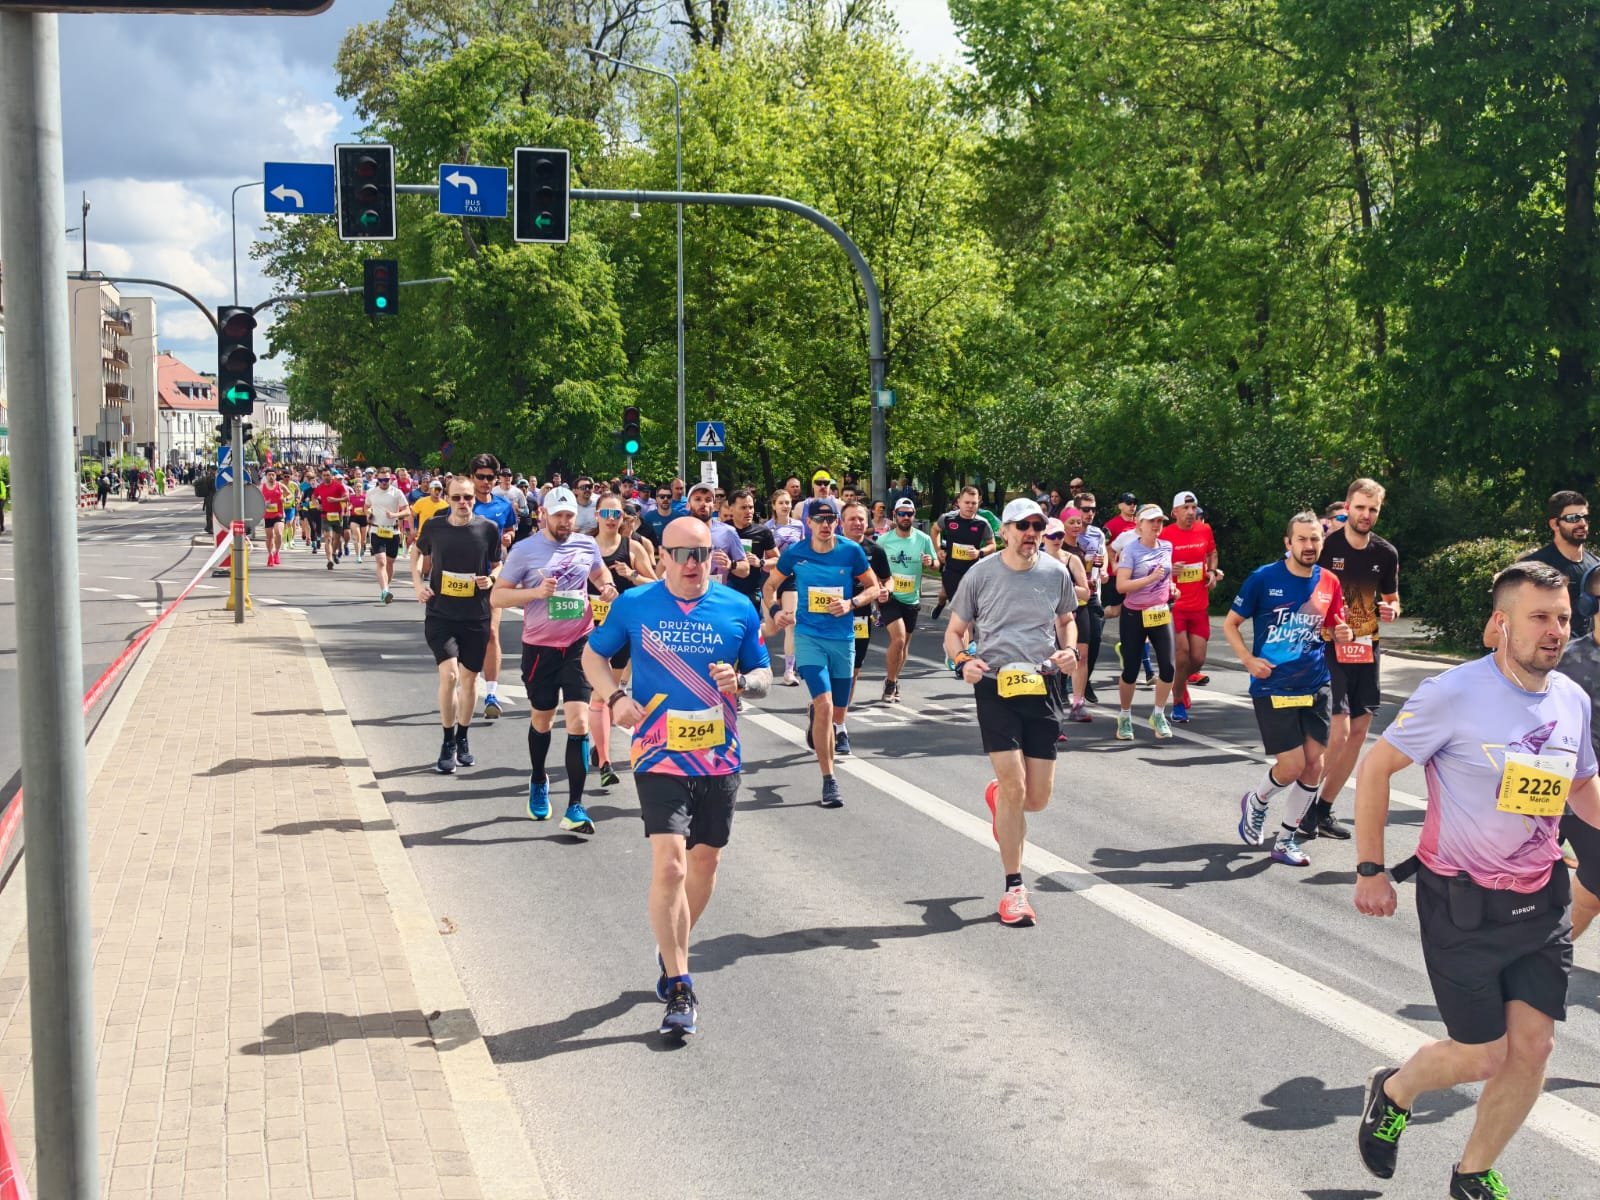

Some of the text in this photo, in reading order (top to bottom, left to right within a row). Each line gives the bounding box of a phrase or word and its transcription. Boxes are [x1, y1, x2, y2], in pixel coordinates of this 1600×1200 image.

[464, 205, 481, 213] TAXI
[448, 580, 469, 589] 2034
[556, 600, 579, 611] 3508
[815, 596, 831, 605] 203
[593, 604, 609, 613] 210
[659, 619, 714, 632] DRUŻYNA
[649, 630, 724, 645] ORZECHA
[659, 643, 715, 654] ŻYRARDÓW
[1342, 645, 1365, 655] 1074
[678, 723, 715, 738] 2264
[1517, 777, 1561, 796] 2226
[1511, 904, 1536, 916] KIPRUN
